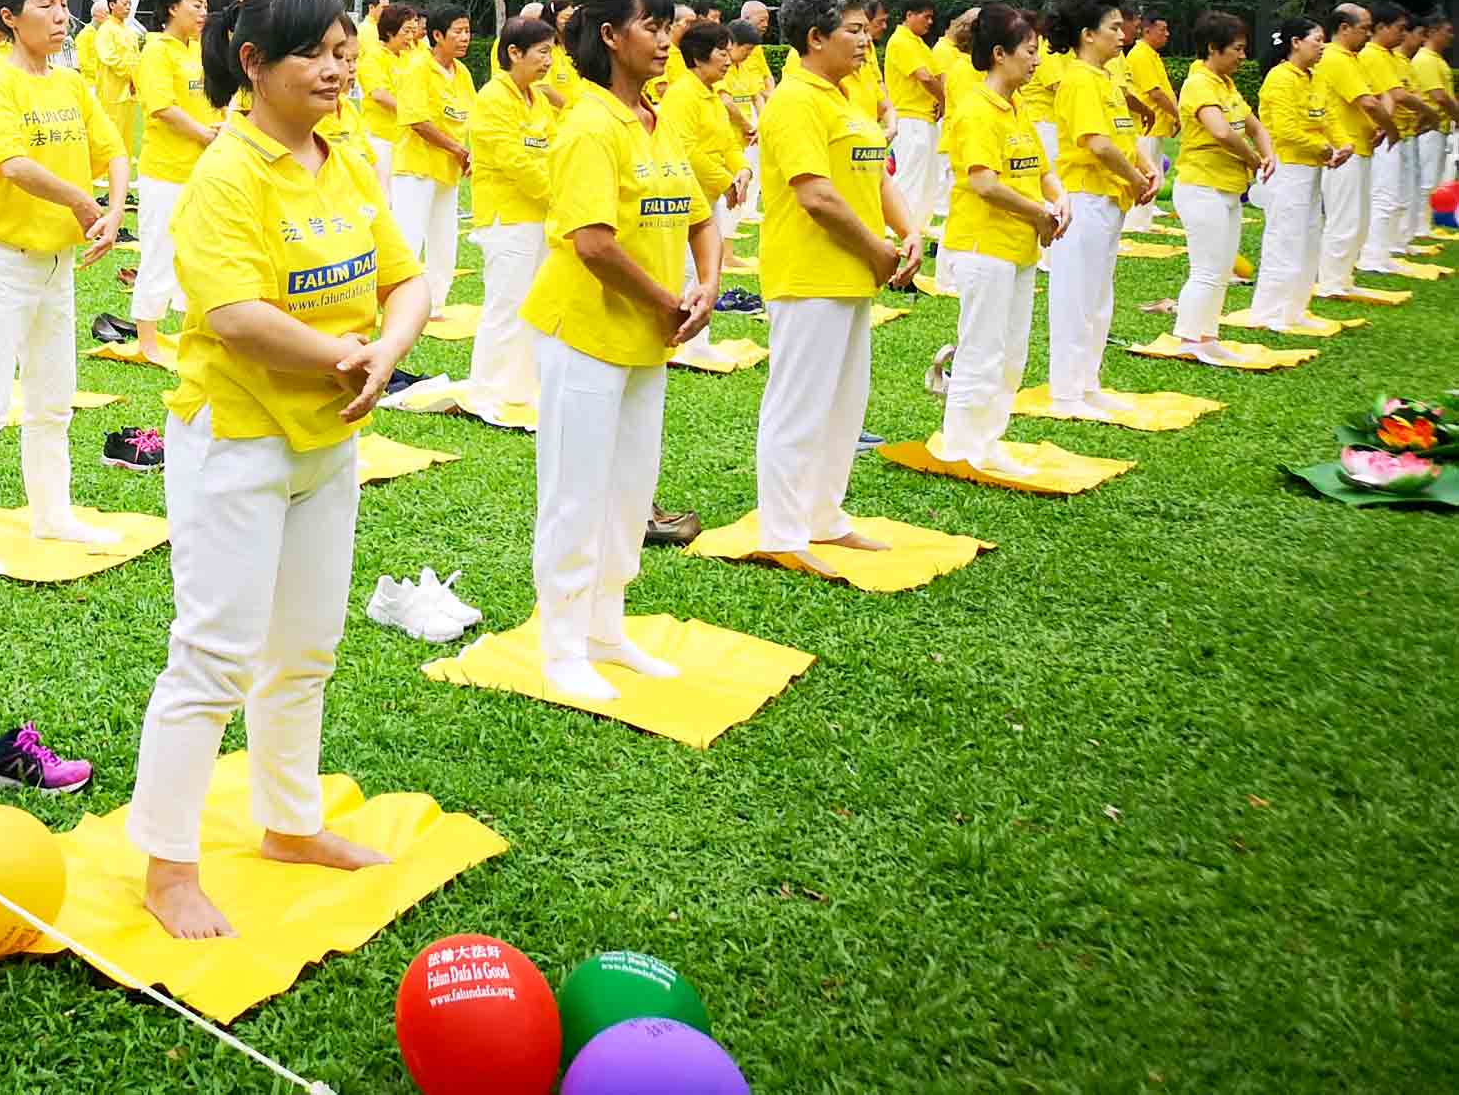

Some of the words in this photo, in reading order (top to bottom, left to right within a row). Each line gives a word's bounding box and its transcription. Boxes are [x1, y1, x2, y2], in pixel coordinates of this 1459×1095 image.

[293, 263, 350, 292] FALUN
[427, 943, 502, 969] 法輪大法好
[427, 969, 451, 992] Falun
[450, 962, 473, 986] Dafa
[483, 961, 511, 980] Good
